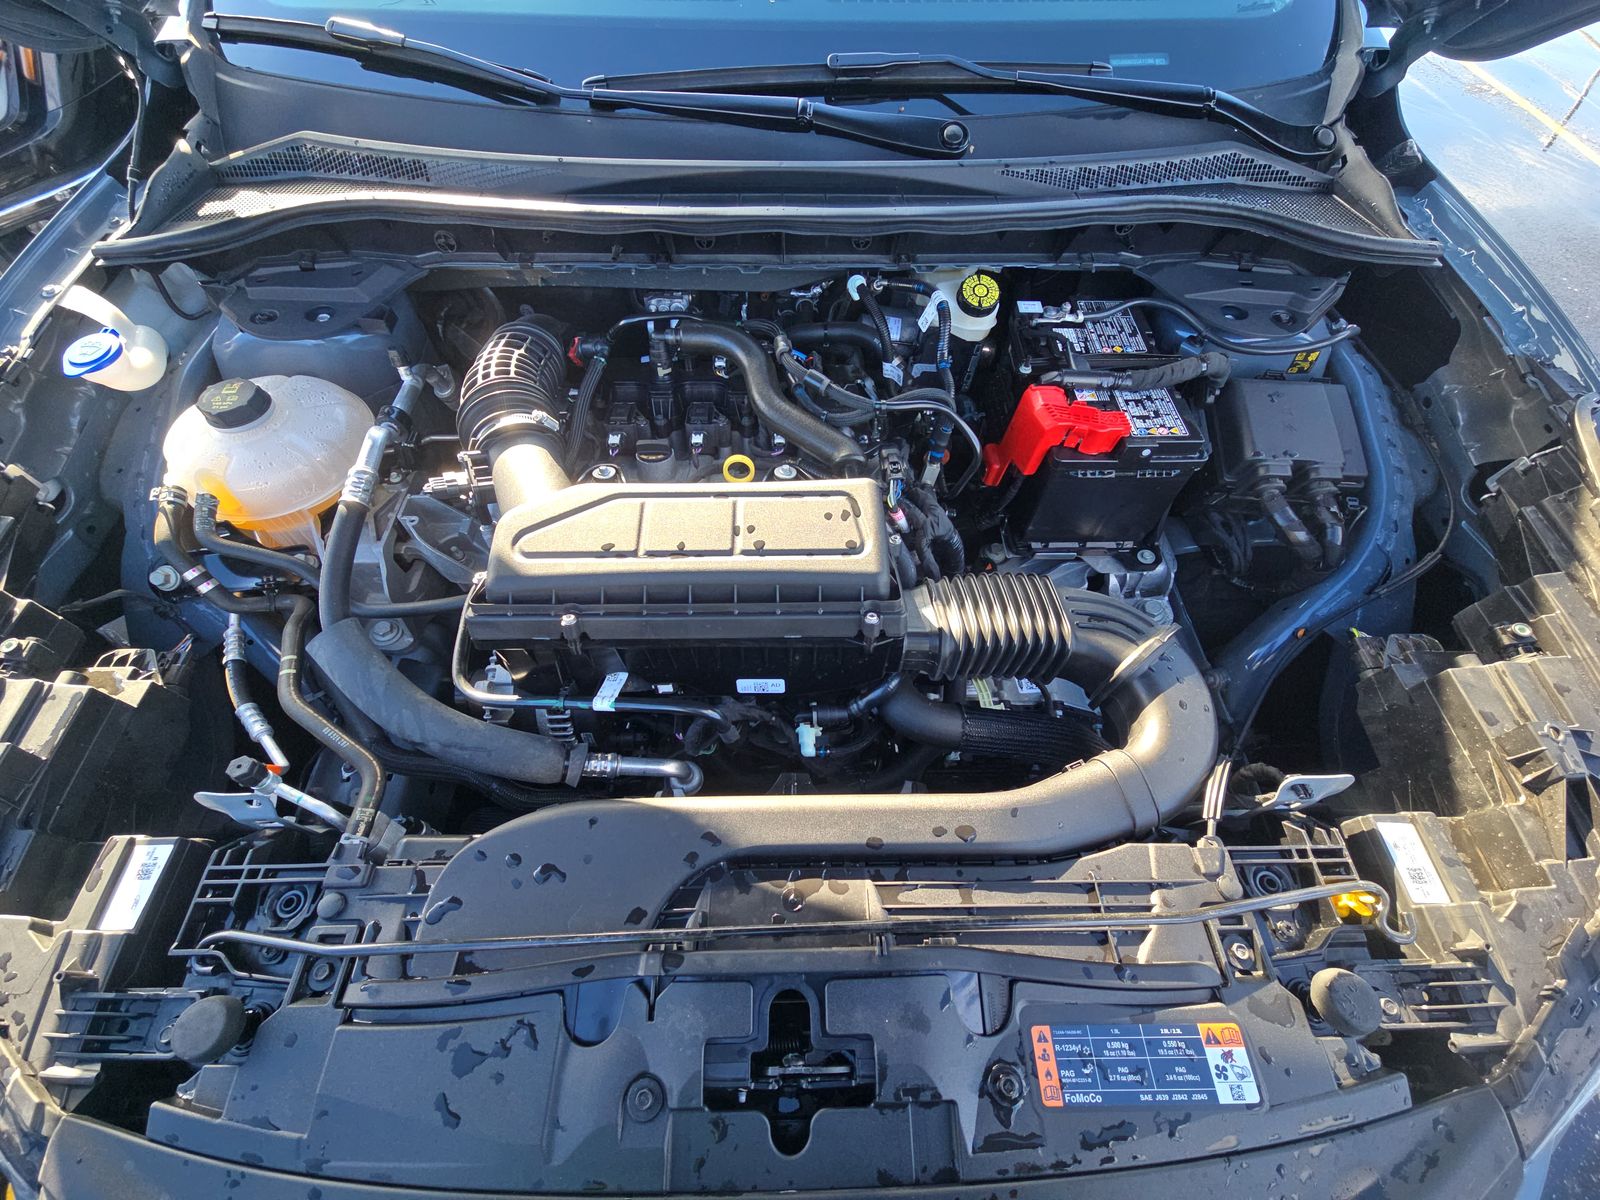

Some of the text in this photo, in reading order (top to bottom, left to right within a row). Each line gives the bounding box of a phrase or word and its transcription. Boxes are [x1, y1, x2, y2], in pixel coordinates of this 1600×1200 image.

[1056, 1044, 1082, 1053] R-1234yf
[1122, 1042, 1130, 1050] kg
[1178, 1040, 1186, 1049] kg
[1060, 1070, 1076, 1078] PAG
[1064, 1094, 1103, 1103] FoMoCo
